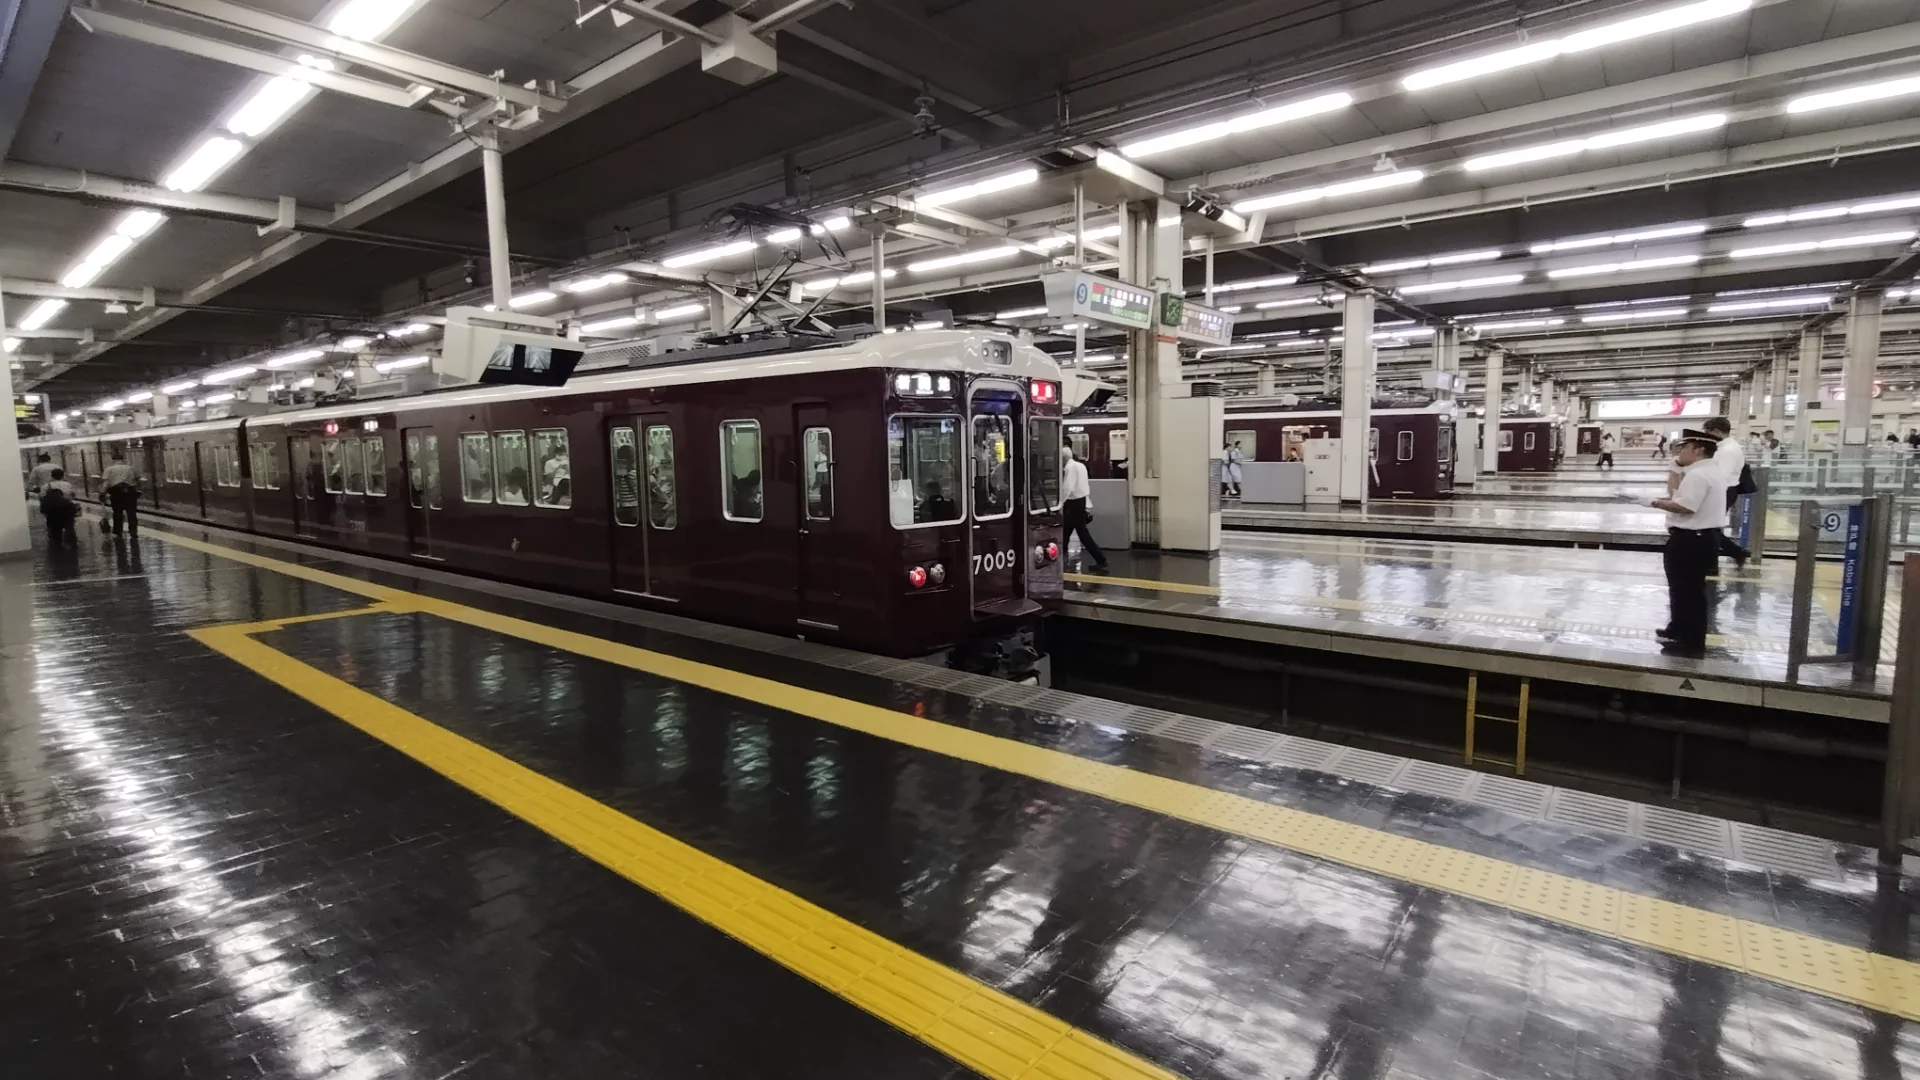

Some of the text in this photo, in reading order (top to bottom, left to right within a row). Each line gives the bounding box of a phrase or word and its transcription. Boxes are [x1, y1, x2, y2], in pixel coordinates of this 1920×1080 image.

[1827, 516, 1838, 530] 9
[972, 549, 1016, 575] 7009
[1846, 559, 1856, 584] Kobe
[1844, 587, 1854, 606] Line
